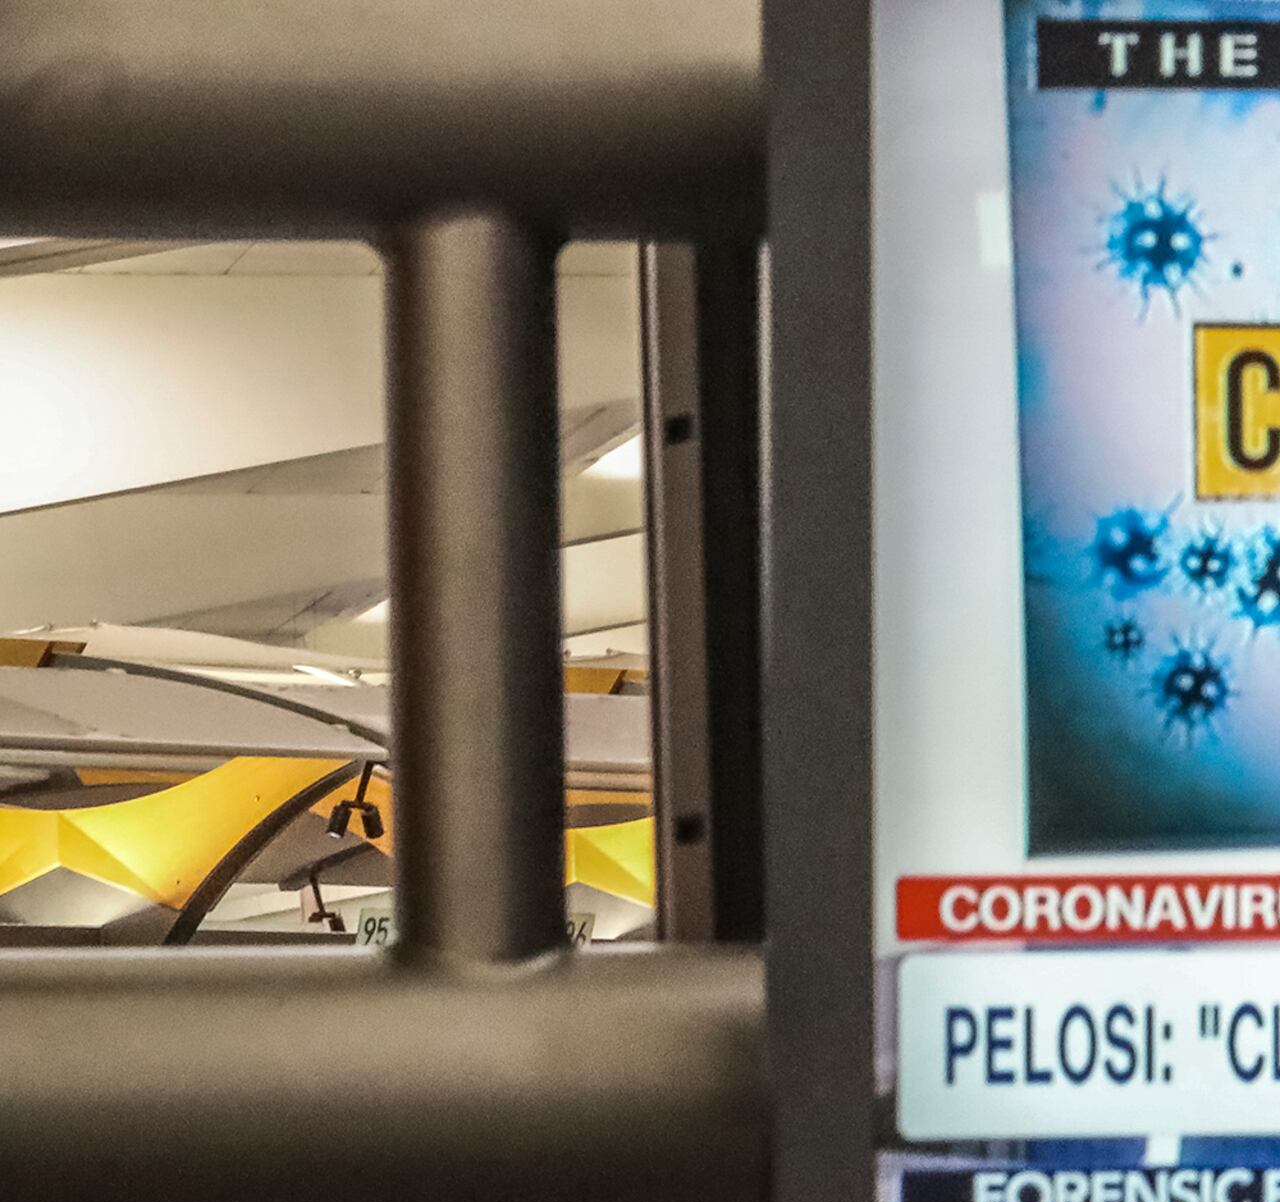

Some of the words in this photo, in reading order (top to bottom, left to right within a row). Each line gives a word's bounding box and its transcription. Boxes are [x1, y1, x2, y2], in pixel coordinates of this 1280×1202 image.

[1098, 32, 1258, 78] THE
[363, 916, 390, 946] 95
[943, 1003, 1173, 1086] PELOSI:
